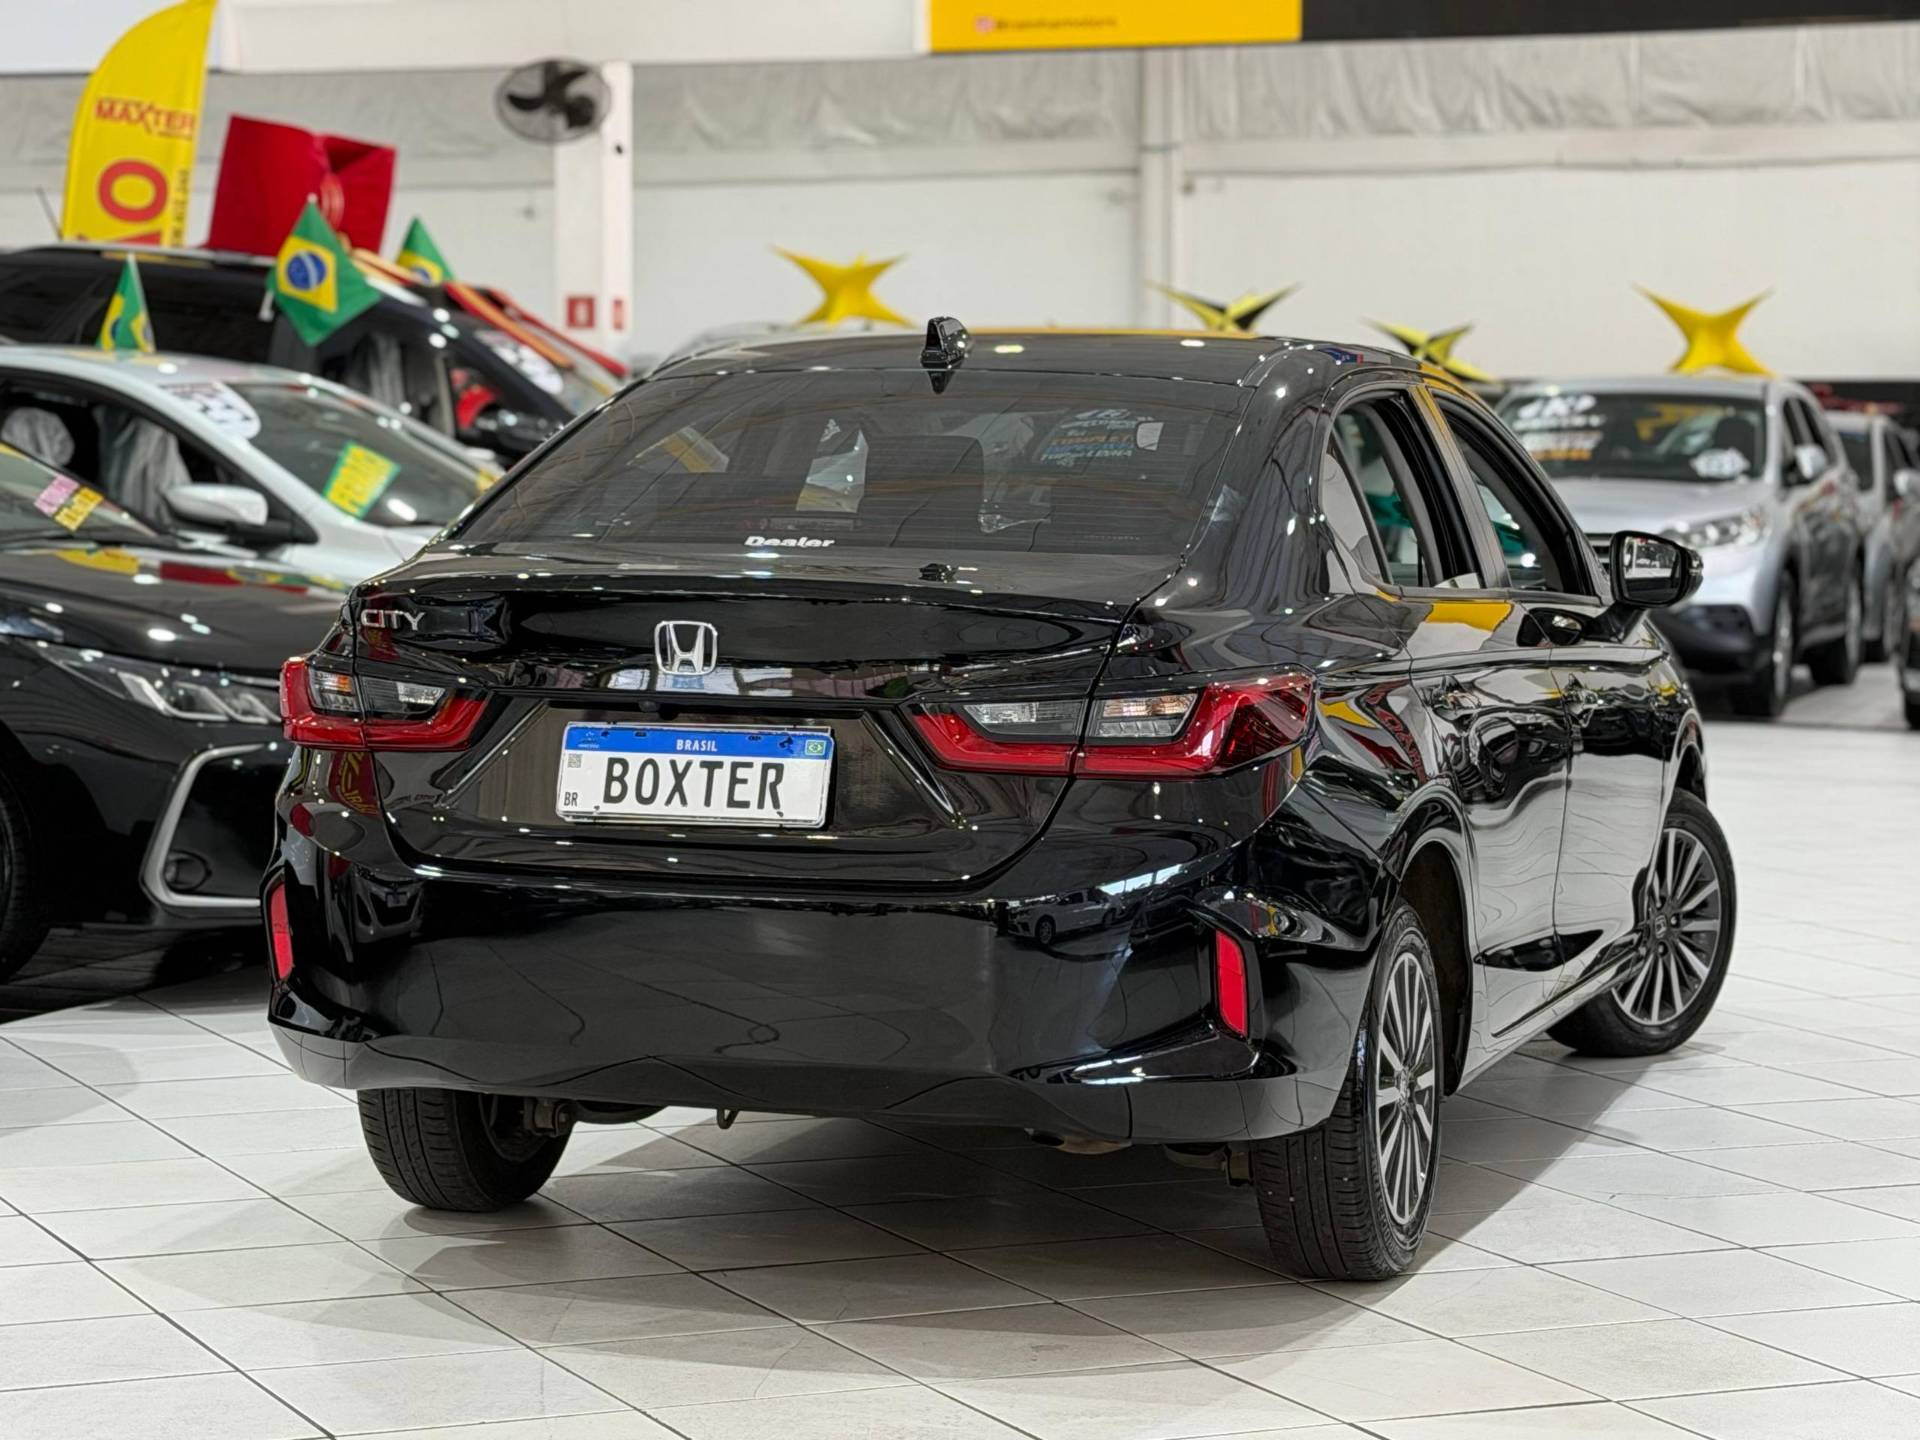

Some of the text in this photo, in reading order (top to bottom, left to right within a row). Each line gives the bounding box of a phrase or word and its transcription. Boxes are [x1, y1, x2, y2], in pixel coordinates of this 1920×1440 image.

[744, 536, 836, 549] Dealer
[361, 609, 426, 631] CITY
[675, 739, 718, 752] BRASIL
[603, 757, 785, 810] BOXTER
[563, 791, 579, 807] BR
